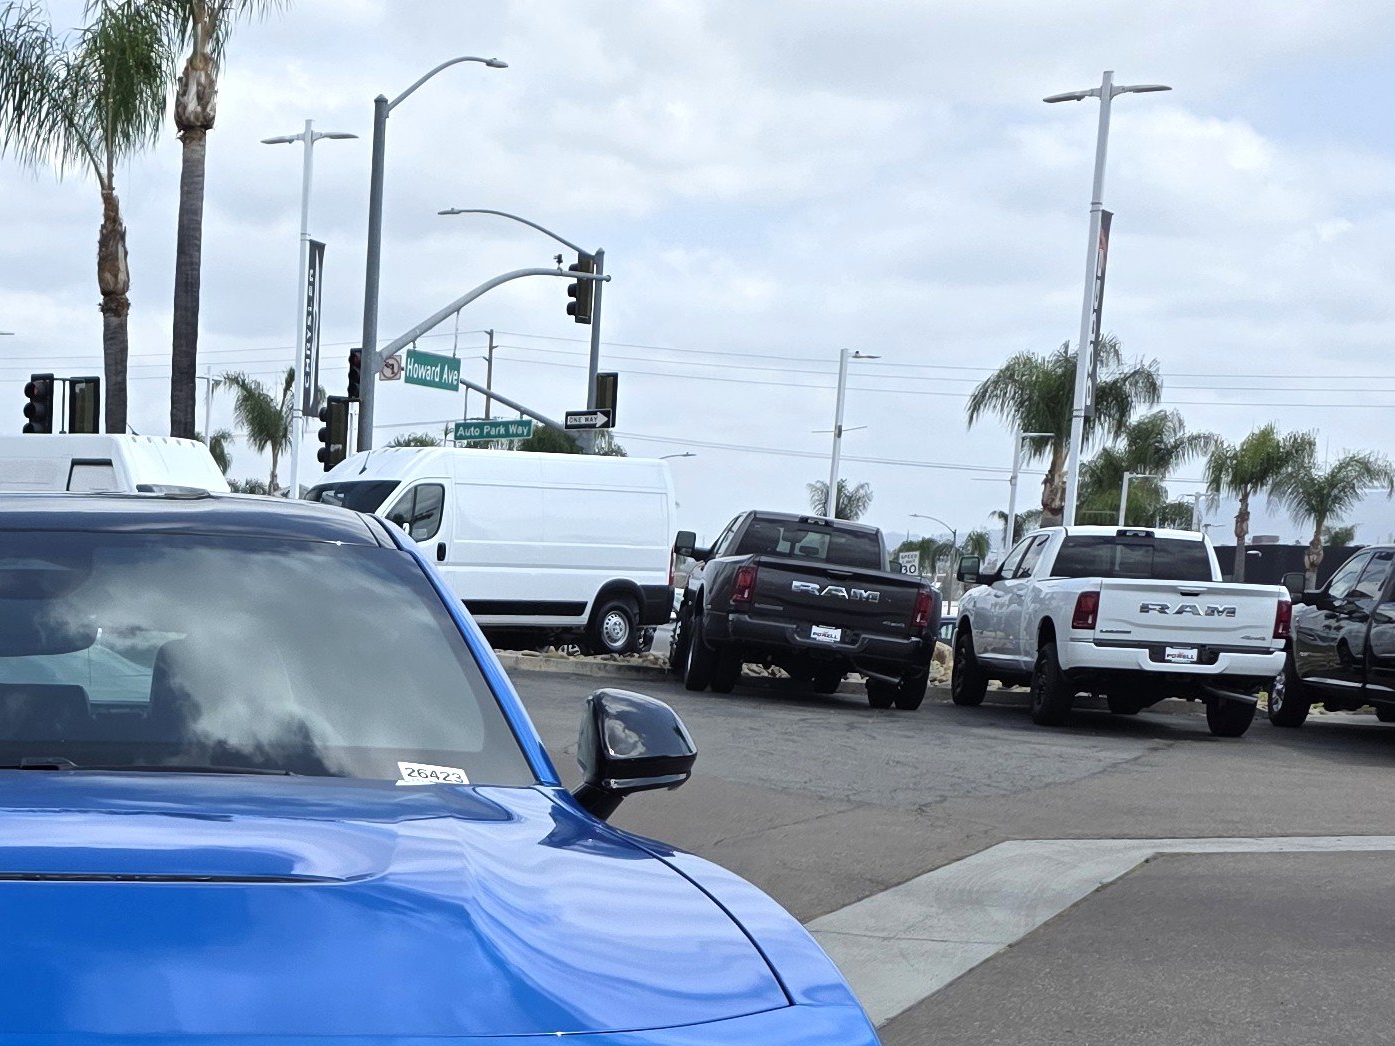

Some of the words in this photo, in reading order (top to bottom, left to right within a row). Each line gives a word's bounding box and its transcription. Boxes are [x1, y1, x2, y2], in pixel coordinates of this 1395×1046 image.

[406, 357, 441, 382] Howard
[441, 364, 458, 385] Ave
[568, 416, 583, 424] ONE
[457, 426, 480, 437] Auto
[483, 425, 506, 436] Park
[508, 423, 529, 436] Way
[901, 565, 917, 574] 30
[791, 580, 881, 603] RAM
[1139, 602, 1237, 618] RAM
[404, 767, 464, 783] 26423
